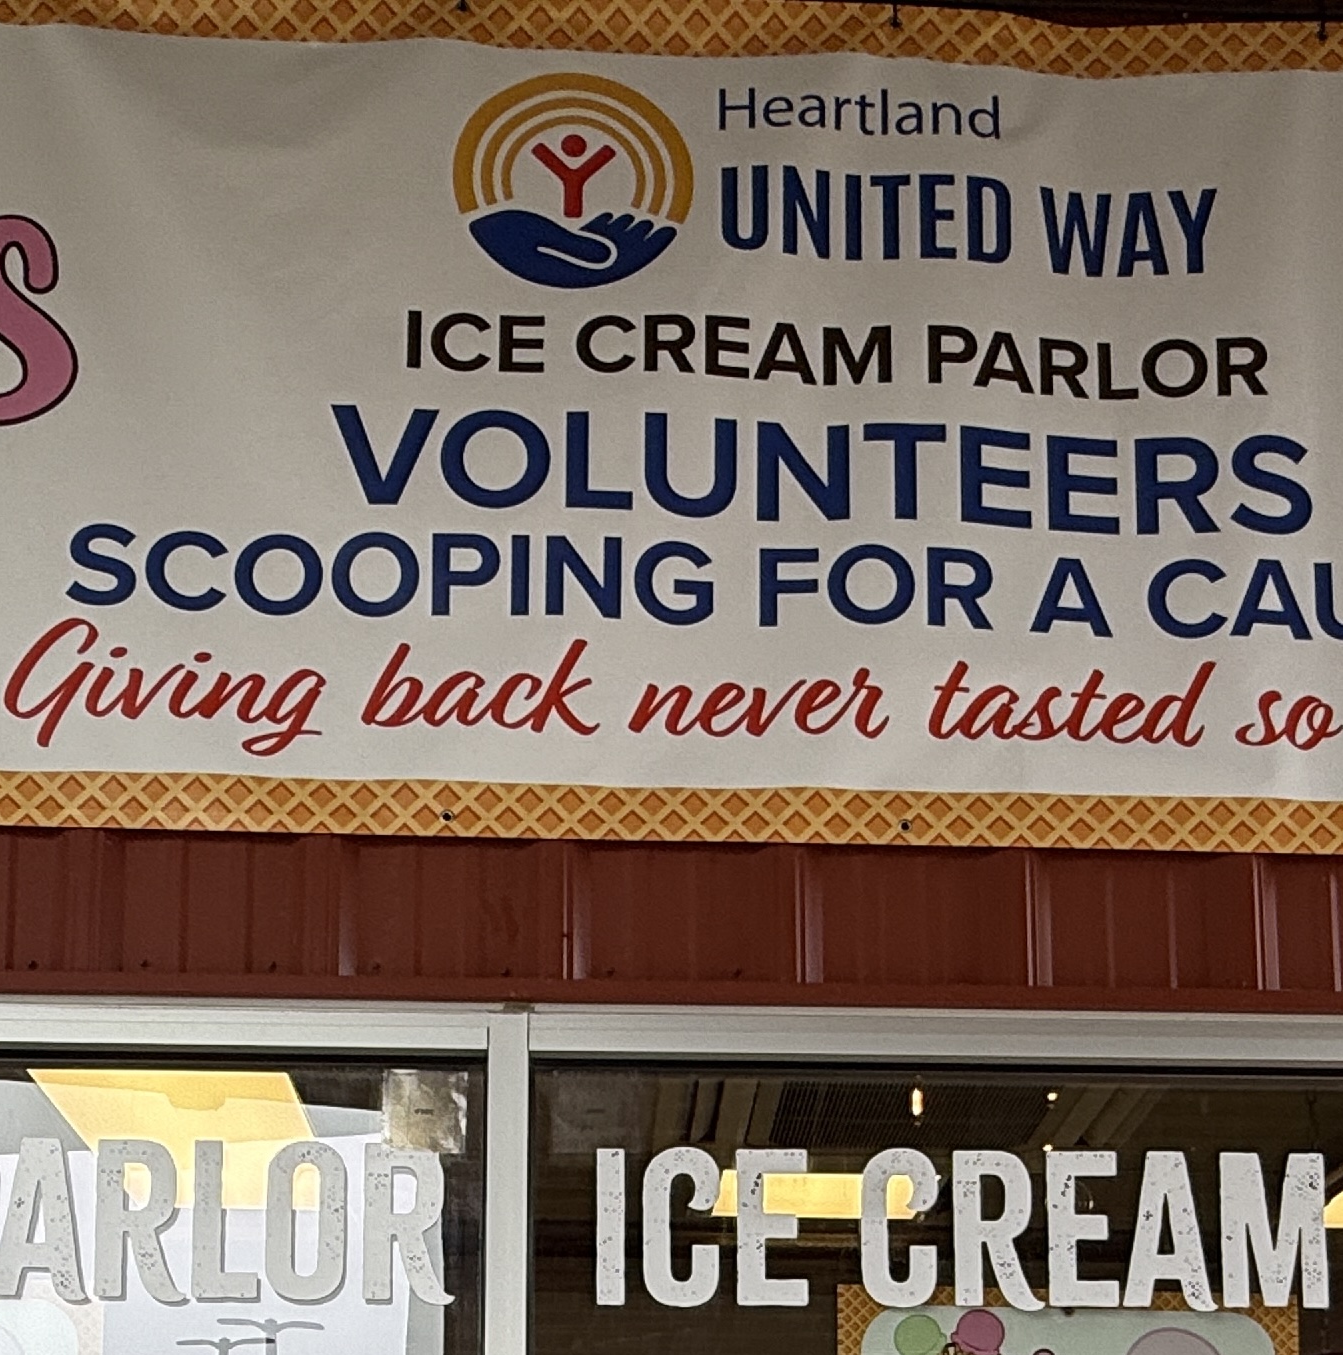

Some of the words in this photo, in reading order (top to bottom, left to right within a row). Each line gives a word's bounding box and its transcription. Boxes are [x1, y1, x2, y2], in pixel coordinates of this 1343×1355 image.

[716, 84, 1003, 143] Heartland
[719, 163, 1010, 267] UNITED
[1044, 184, 1218, 281] WAY
[402, 309, 546, 377] ICE
[575, 314, 895, 388] CREAM
[926, 325, 1271, 404] PARLOR
[329, 404, 1314, 539] VOLUNTEERS
[65, 523, 716, 629] SCOOPING
[758, 540, 992, 630] FOR
[1030, 558, 1114, 641] A
[2, 616, 328, 761] Giving
[362, 640, 601, 738] back
[627, 667, 890, 745] never
[928, 661, 1207, 752] tasted
[596, 1146, 809, 1308] ICE
[859, 1146, 1329, 1311] CREAM
